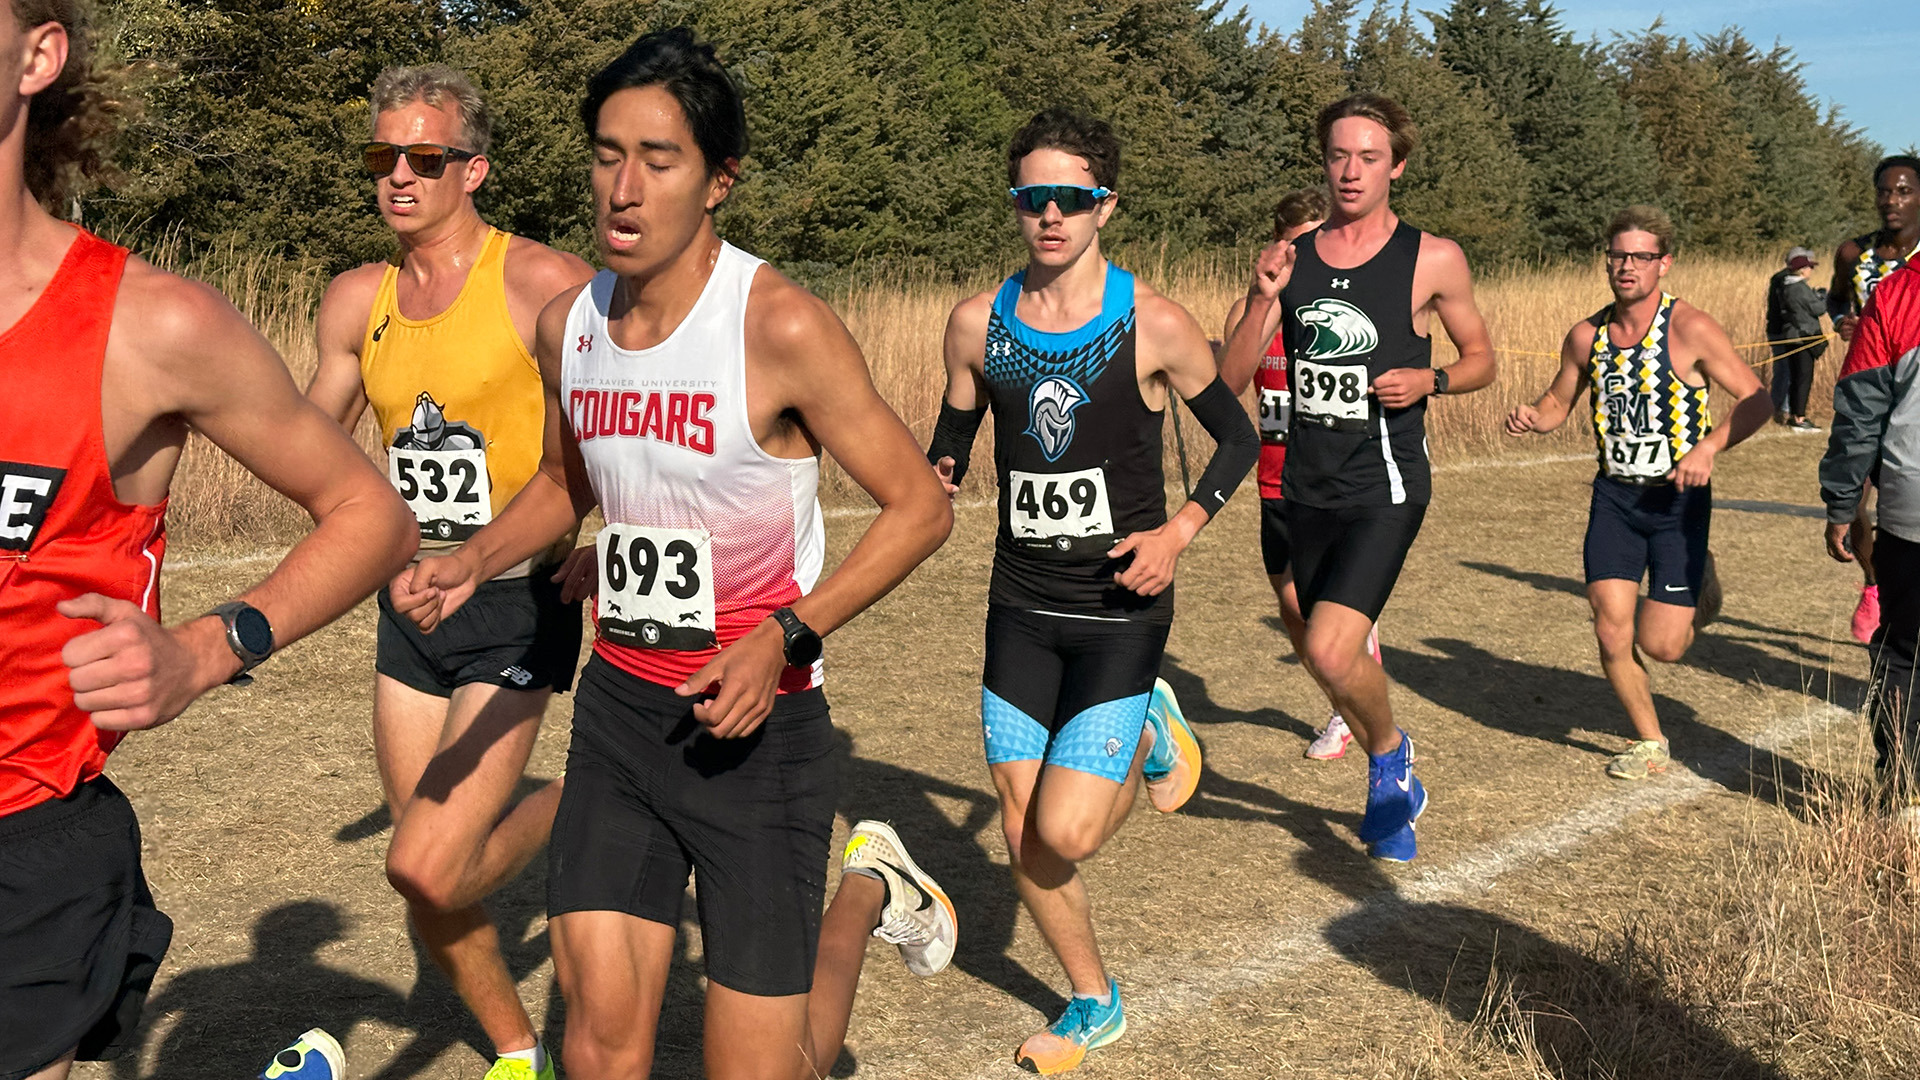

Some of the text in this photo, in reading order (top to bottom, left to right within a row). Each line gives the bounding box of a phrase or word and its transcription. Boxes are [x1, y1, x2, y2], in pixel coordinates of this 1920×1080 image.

[641, 380, 718, 388] UNIVERSITY
[1299, 367, 1360, 404] 398
[569, 387, 717, 457] COUGARS
[1260, 392, 1291, 420] 61
[1612, 441, 1661, 464] 677
[397, 457, 479, 503] 532
[1016, 478, 1097, 520] 469
[0, 474, 52, 541] E
[606, 533, 700, 600] 693
